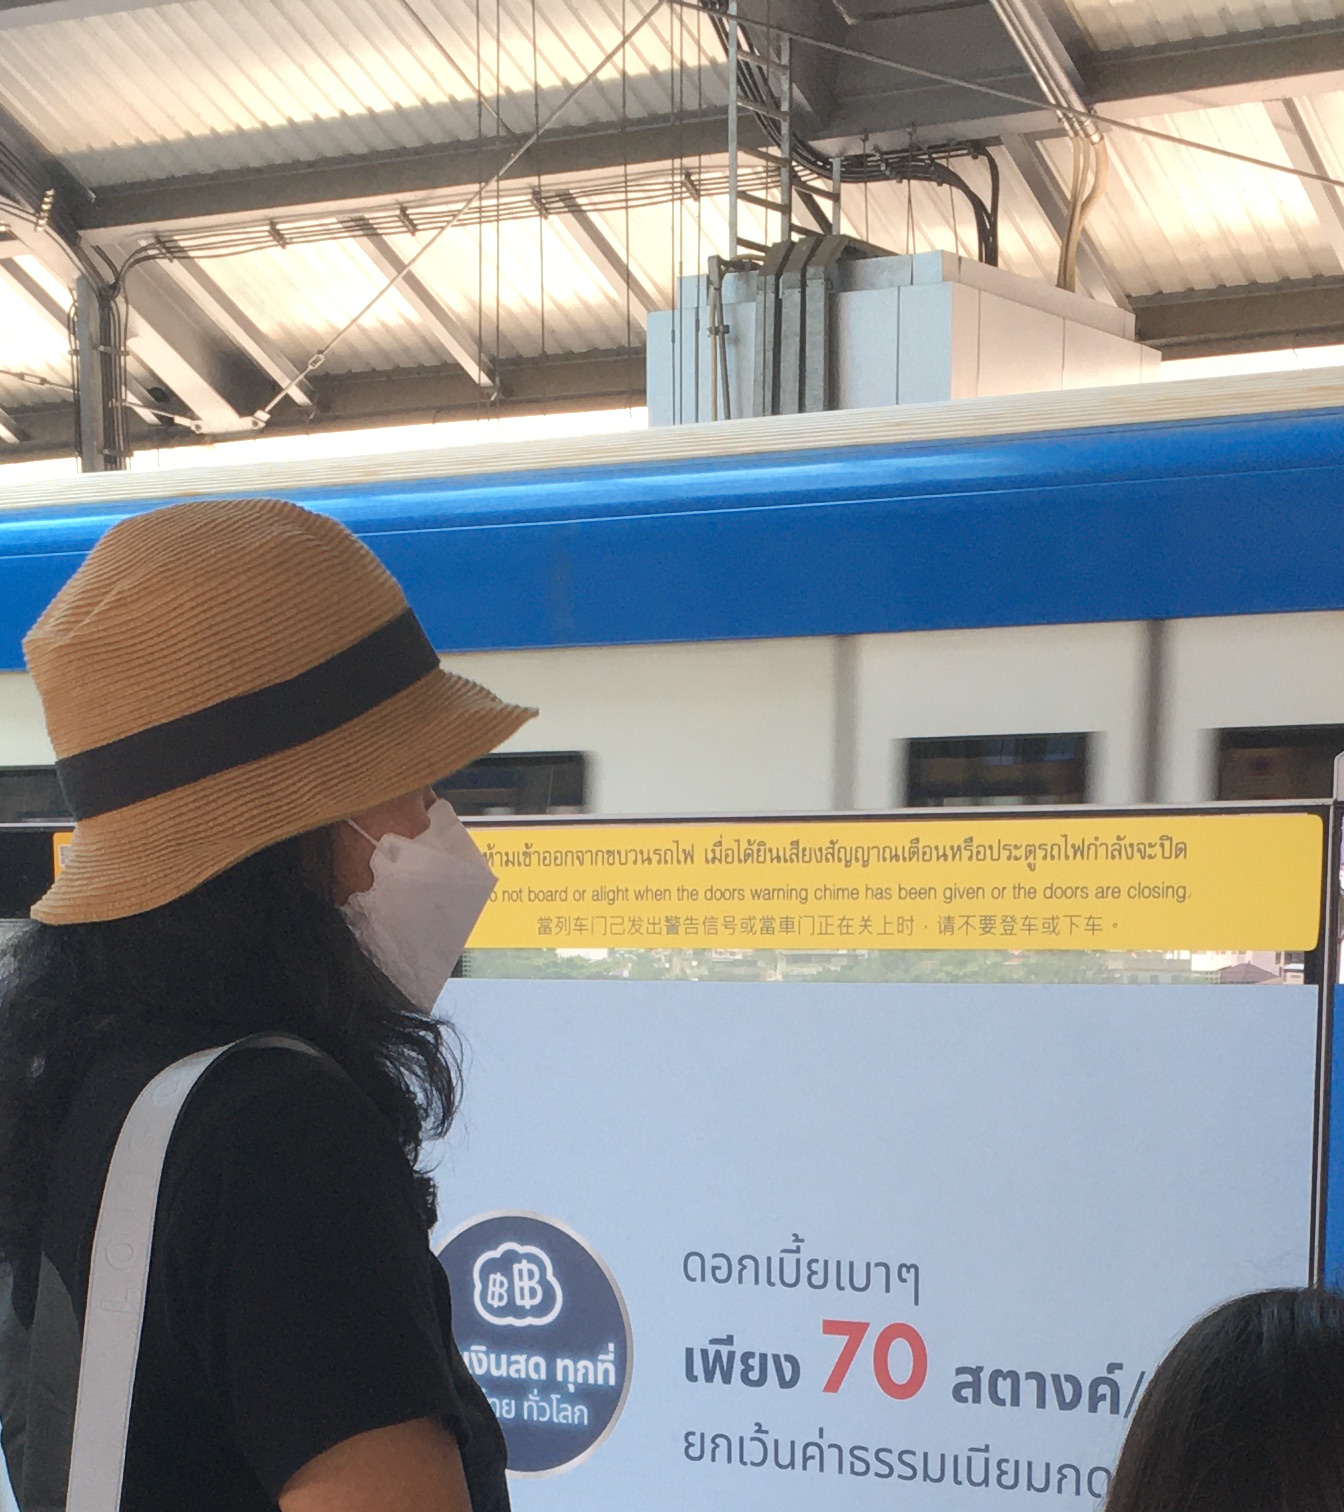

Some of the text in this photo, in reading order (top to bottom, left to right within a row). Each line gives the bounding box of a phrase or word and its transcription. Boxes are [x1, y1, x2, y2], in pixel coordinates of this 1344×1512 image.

[502, 887, 523, 902] not
[527, 886, 568, 902] board
[572, 888, 586, 902] or
[591, 885, 629, 906] alight
[634, 885, 671, 902] when
[676, 885, 699, 901] the
[704, 884, 745, 901] doors
[750, 884, 808, 904] warning
[814, 883, 859, 901] chime
[865, 883, 893, 900] has
[898, 883, 937, 900] been
[943, 882, 985, 904] given
[990, 885, 1007, 900] or
[1012, 882, 1037, 899] the
[1043, 881, 1089, 899] doors
[1094, 885, 1122, 899] are
[682, 1232, 923, 1306] ดอกเบี้ยเบาๆ
[556, 1342, 617, 1393] ทุกที่
[683, 1332, 802, 1392] เพียง
[819, 1318, 929, 1402] 70
[523, 1388, 589, 1426] ทั่วโลก
[683, 1421, 1112, 1499] ยกเว้นค่าธรรมเนียมกด
